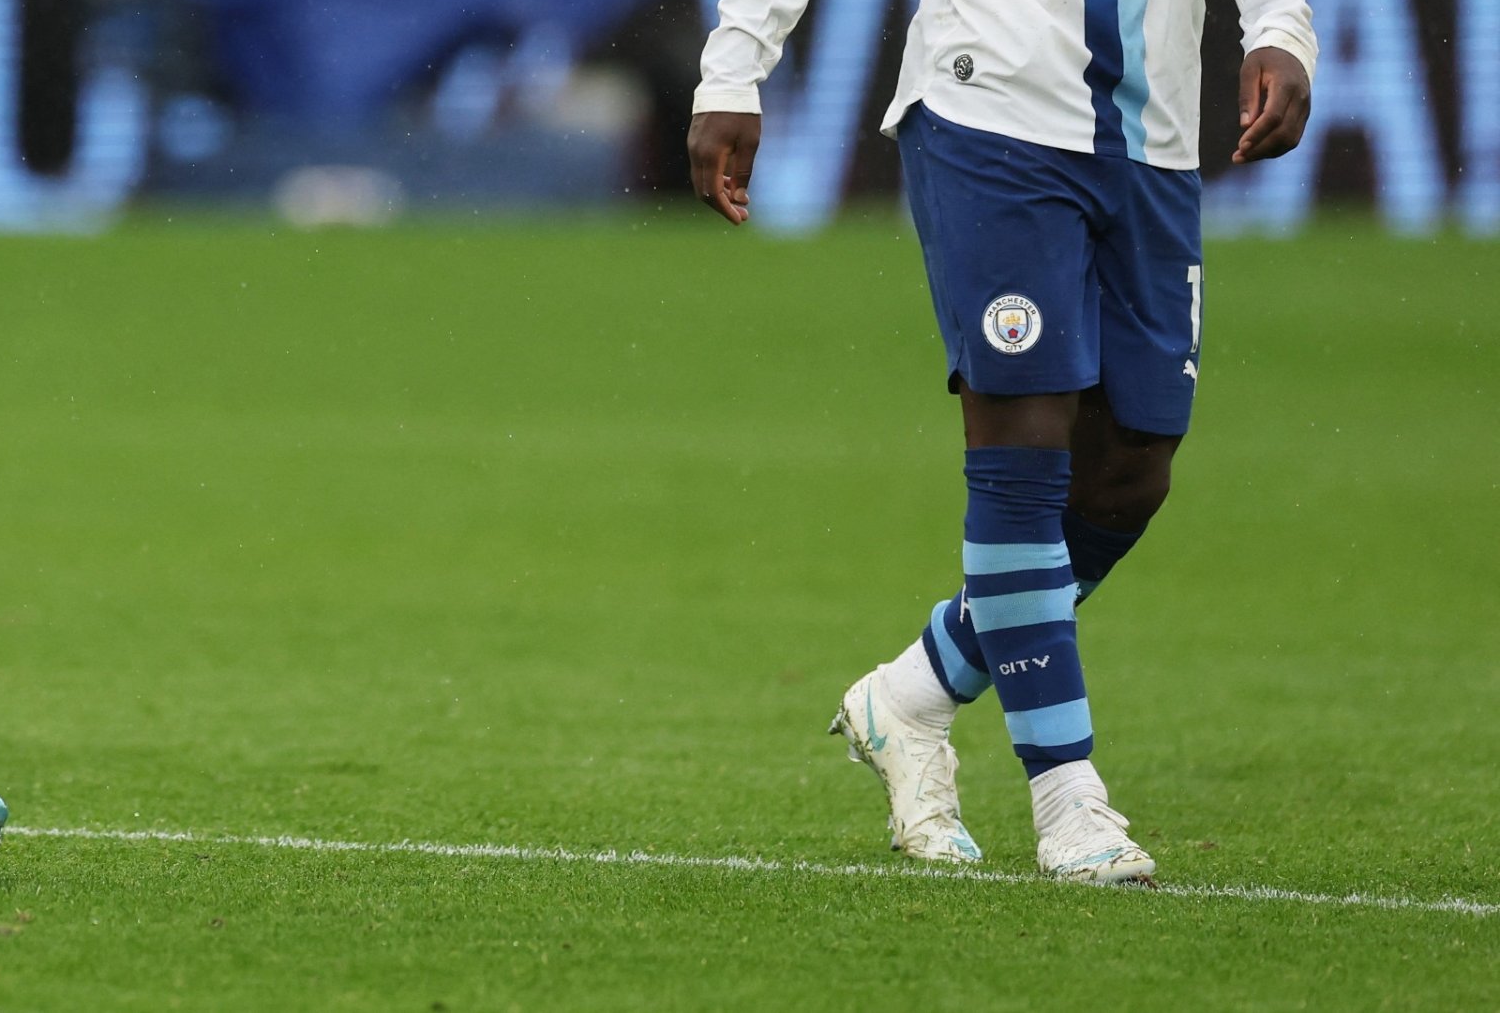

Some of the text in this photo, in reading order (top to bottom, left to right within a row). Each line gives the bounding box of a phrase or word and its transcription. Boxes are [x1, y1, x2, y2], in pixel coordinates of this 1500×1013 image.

[987, 297, 1037, 317] MANCHESTER
[1187, 265, 1205, 354] 1
[999, 654, 1050, 676] CITY
